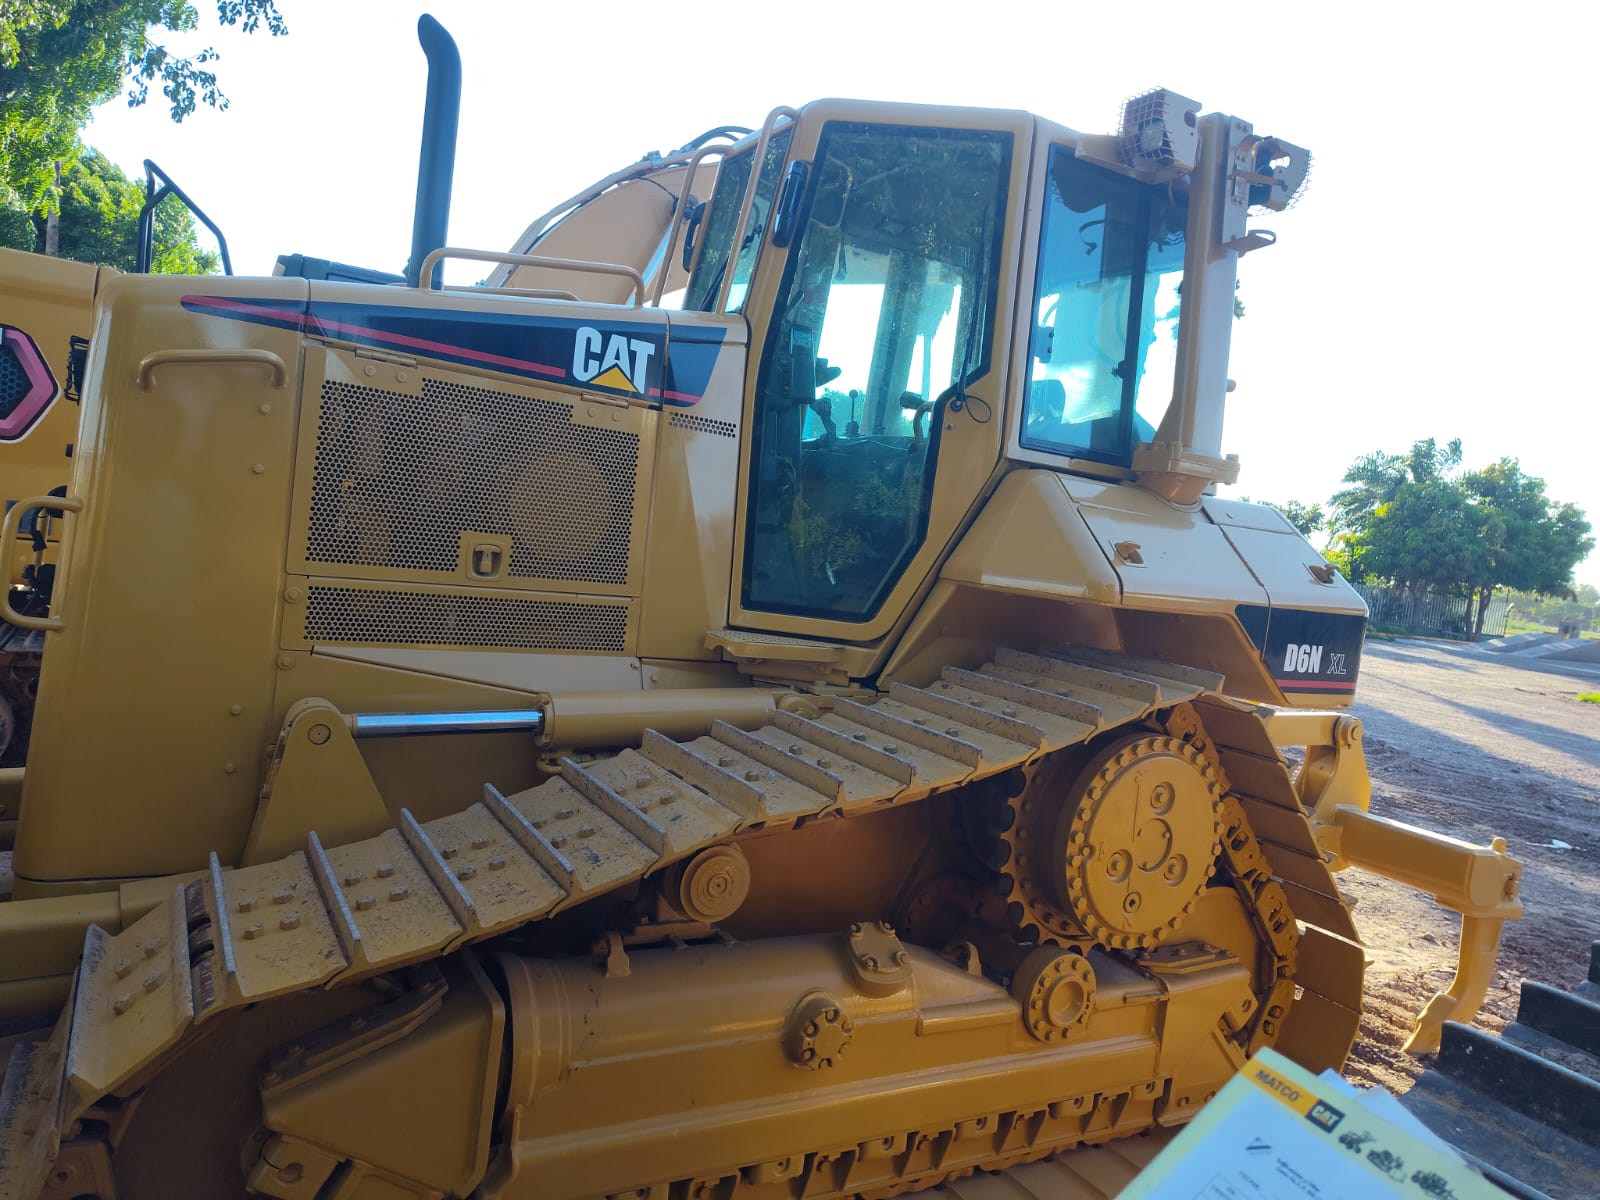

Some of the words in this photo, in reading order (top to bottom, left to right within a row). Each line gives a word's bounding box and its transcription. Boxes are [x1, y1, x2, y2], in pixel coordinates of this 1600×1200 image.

[572, 326, 656, 394] CAT
[1283, 643, 1324, 674] D6N
[1326, 653, 1347, 675] XL
[1256, 1069, 1300, 1102] MATCO
[1312, 1105, 1341, 1127] CAT
